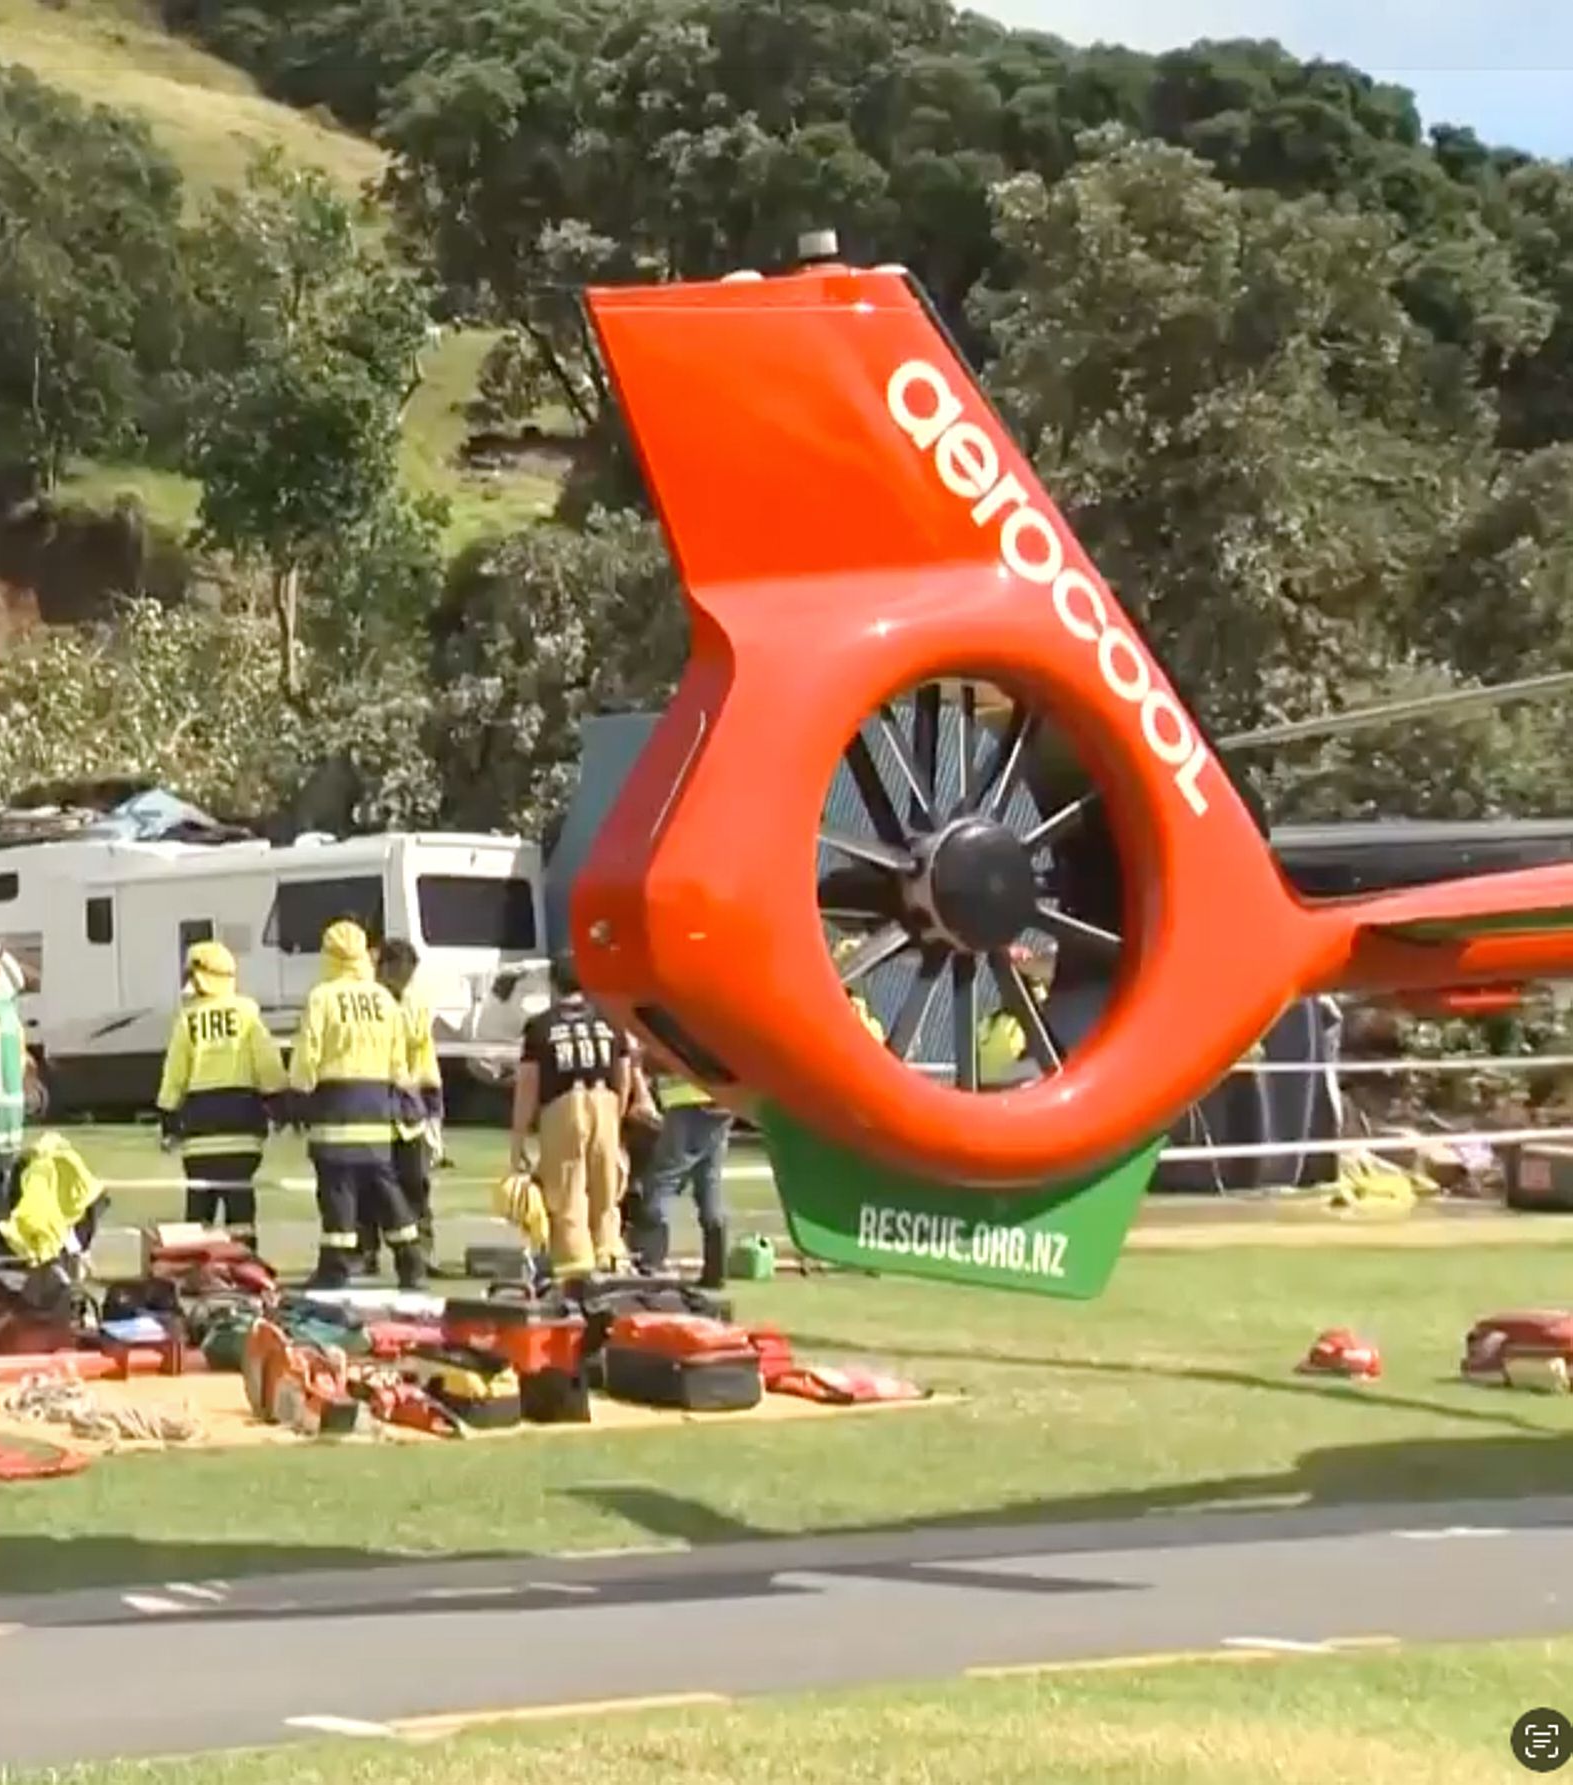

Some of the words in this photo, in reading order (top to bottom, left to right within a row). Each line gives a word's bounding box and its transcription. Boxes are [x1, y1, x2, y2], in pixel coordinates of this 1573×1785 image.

[187, 1007, 238, 1047] FIRE
[337, 991, 384, 1023] FIRE
[857, 1204, 1069, 1278] RESCUE.ORG.NZ
